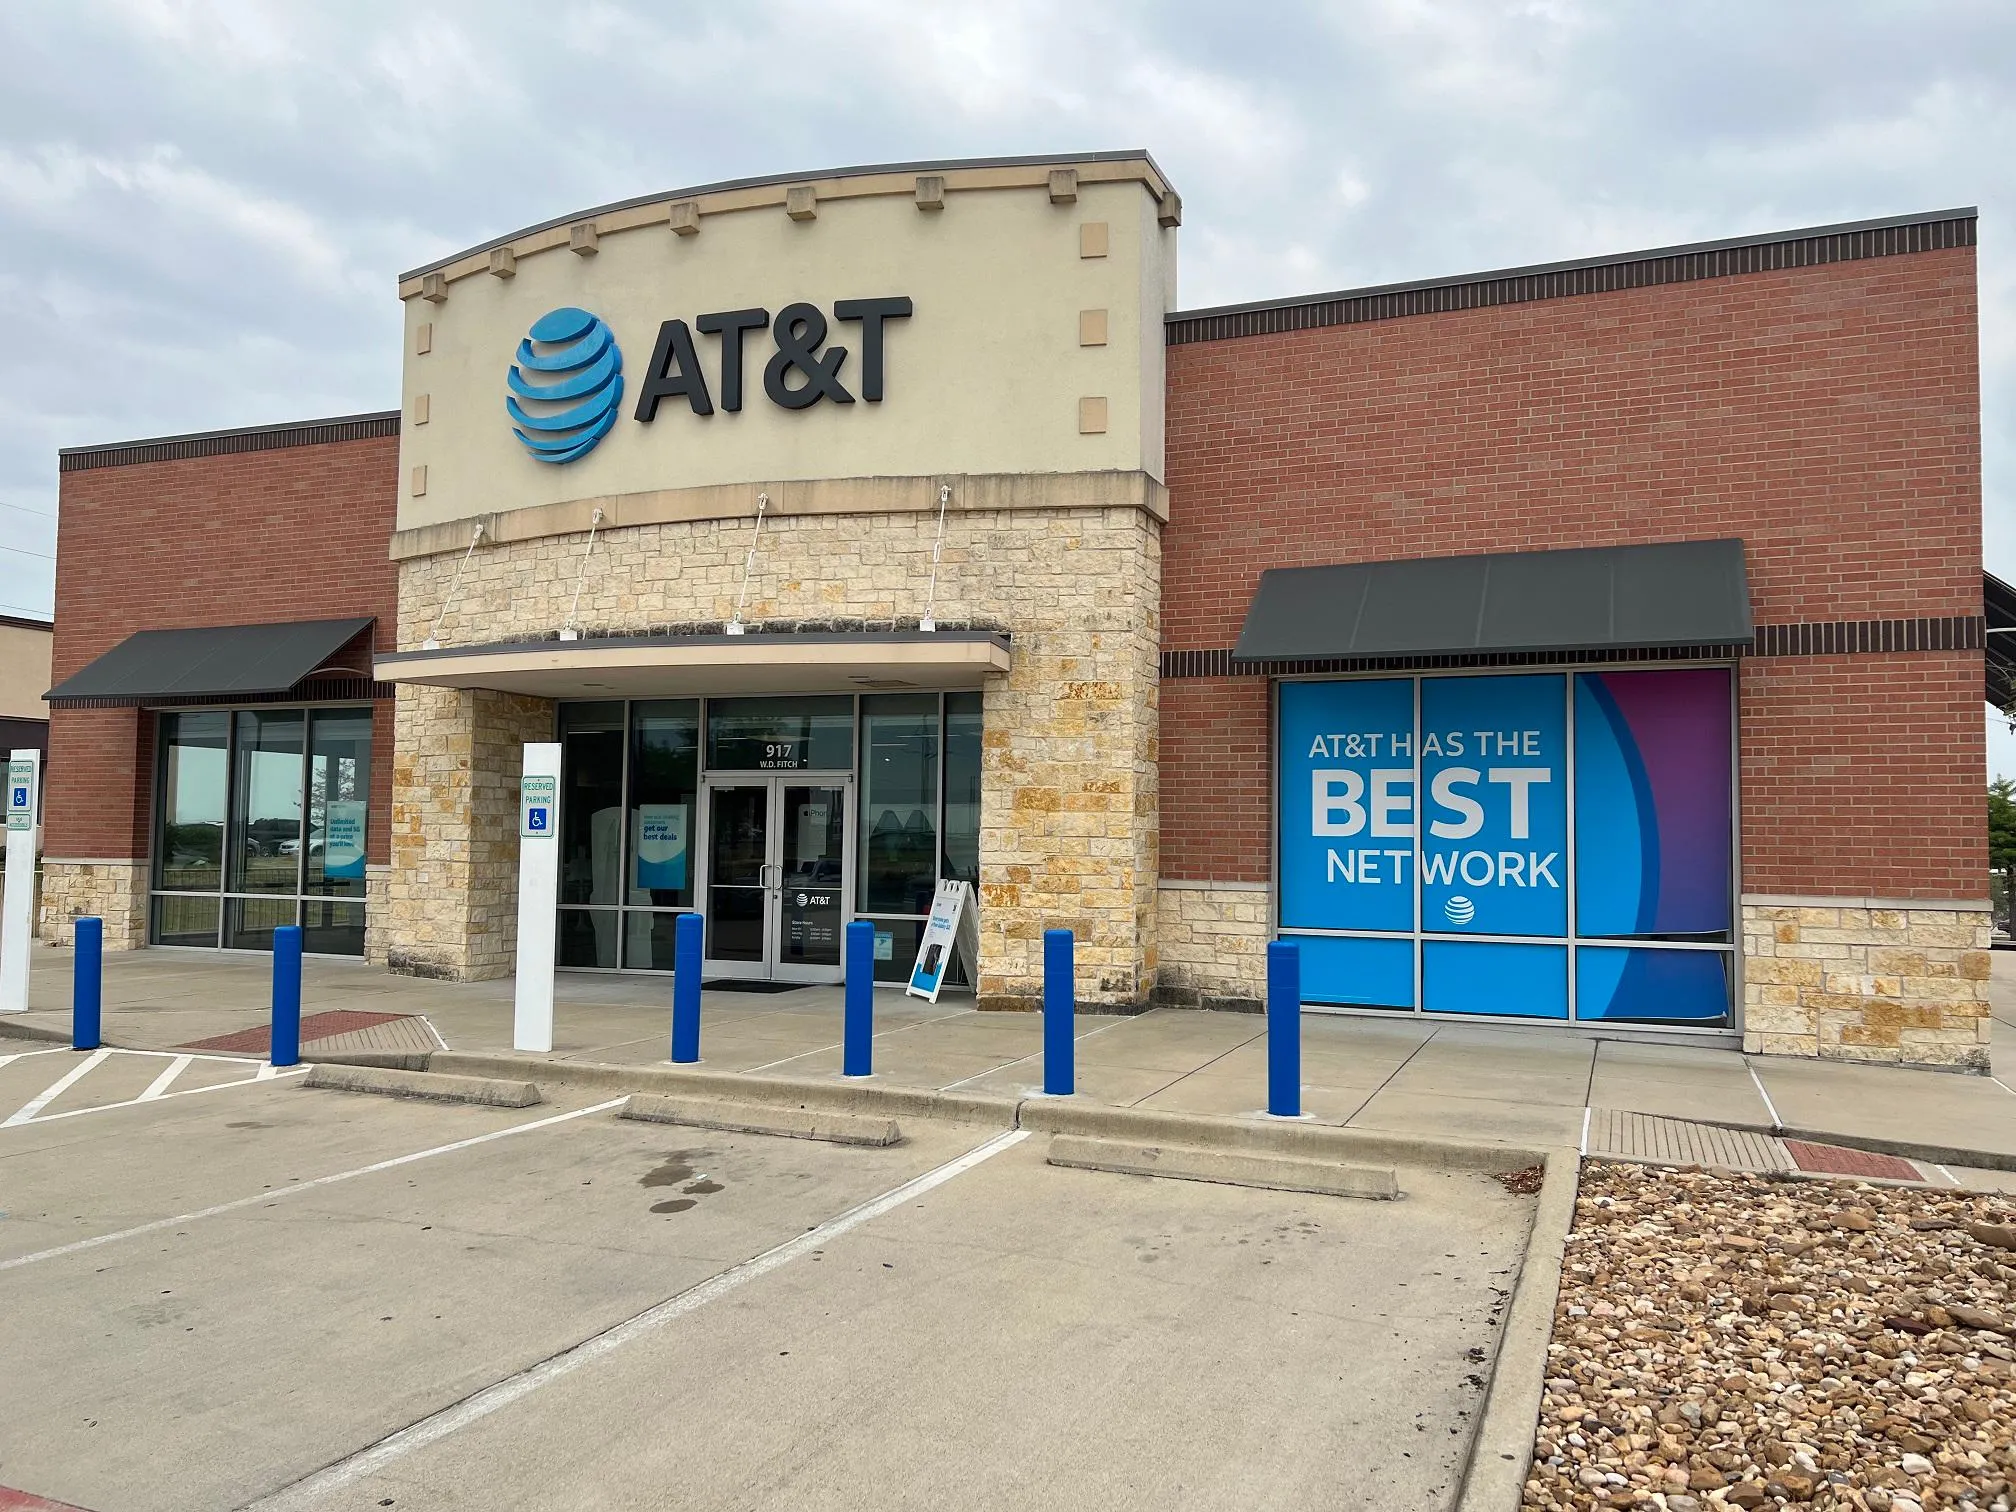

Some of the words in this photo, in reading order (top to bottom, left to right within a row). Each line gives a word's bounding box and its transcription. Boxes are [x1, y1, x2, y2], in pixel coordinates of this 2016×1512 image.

[634, 296, 912, 423] AT&T
[766, 744, 792, 758] 917
[1308, 733, 1383, 758] AT&T
[1391, 731, 1465, 757] HAS
[1474, 730, 1541, 756] THE
[760, 760, 776, 768] W.D.
[777, 760, 798, 768] FITCH
[1311, 766, 1551, 839] BEST
[643, 825, 655, 833] get
[1327, 849, 1560, 888] NETWORK
[809, 896, 831, 905] AT&T
